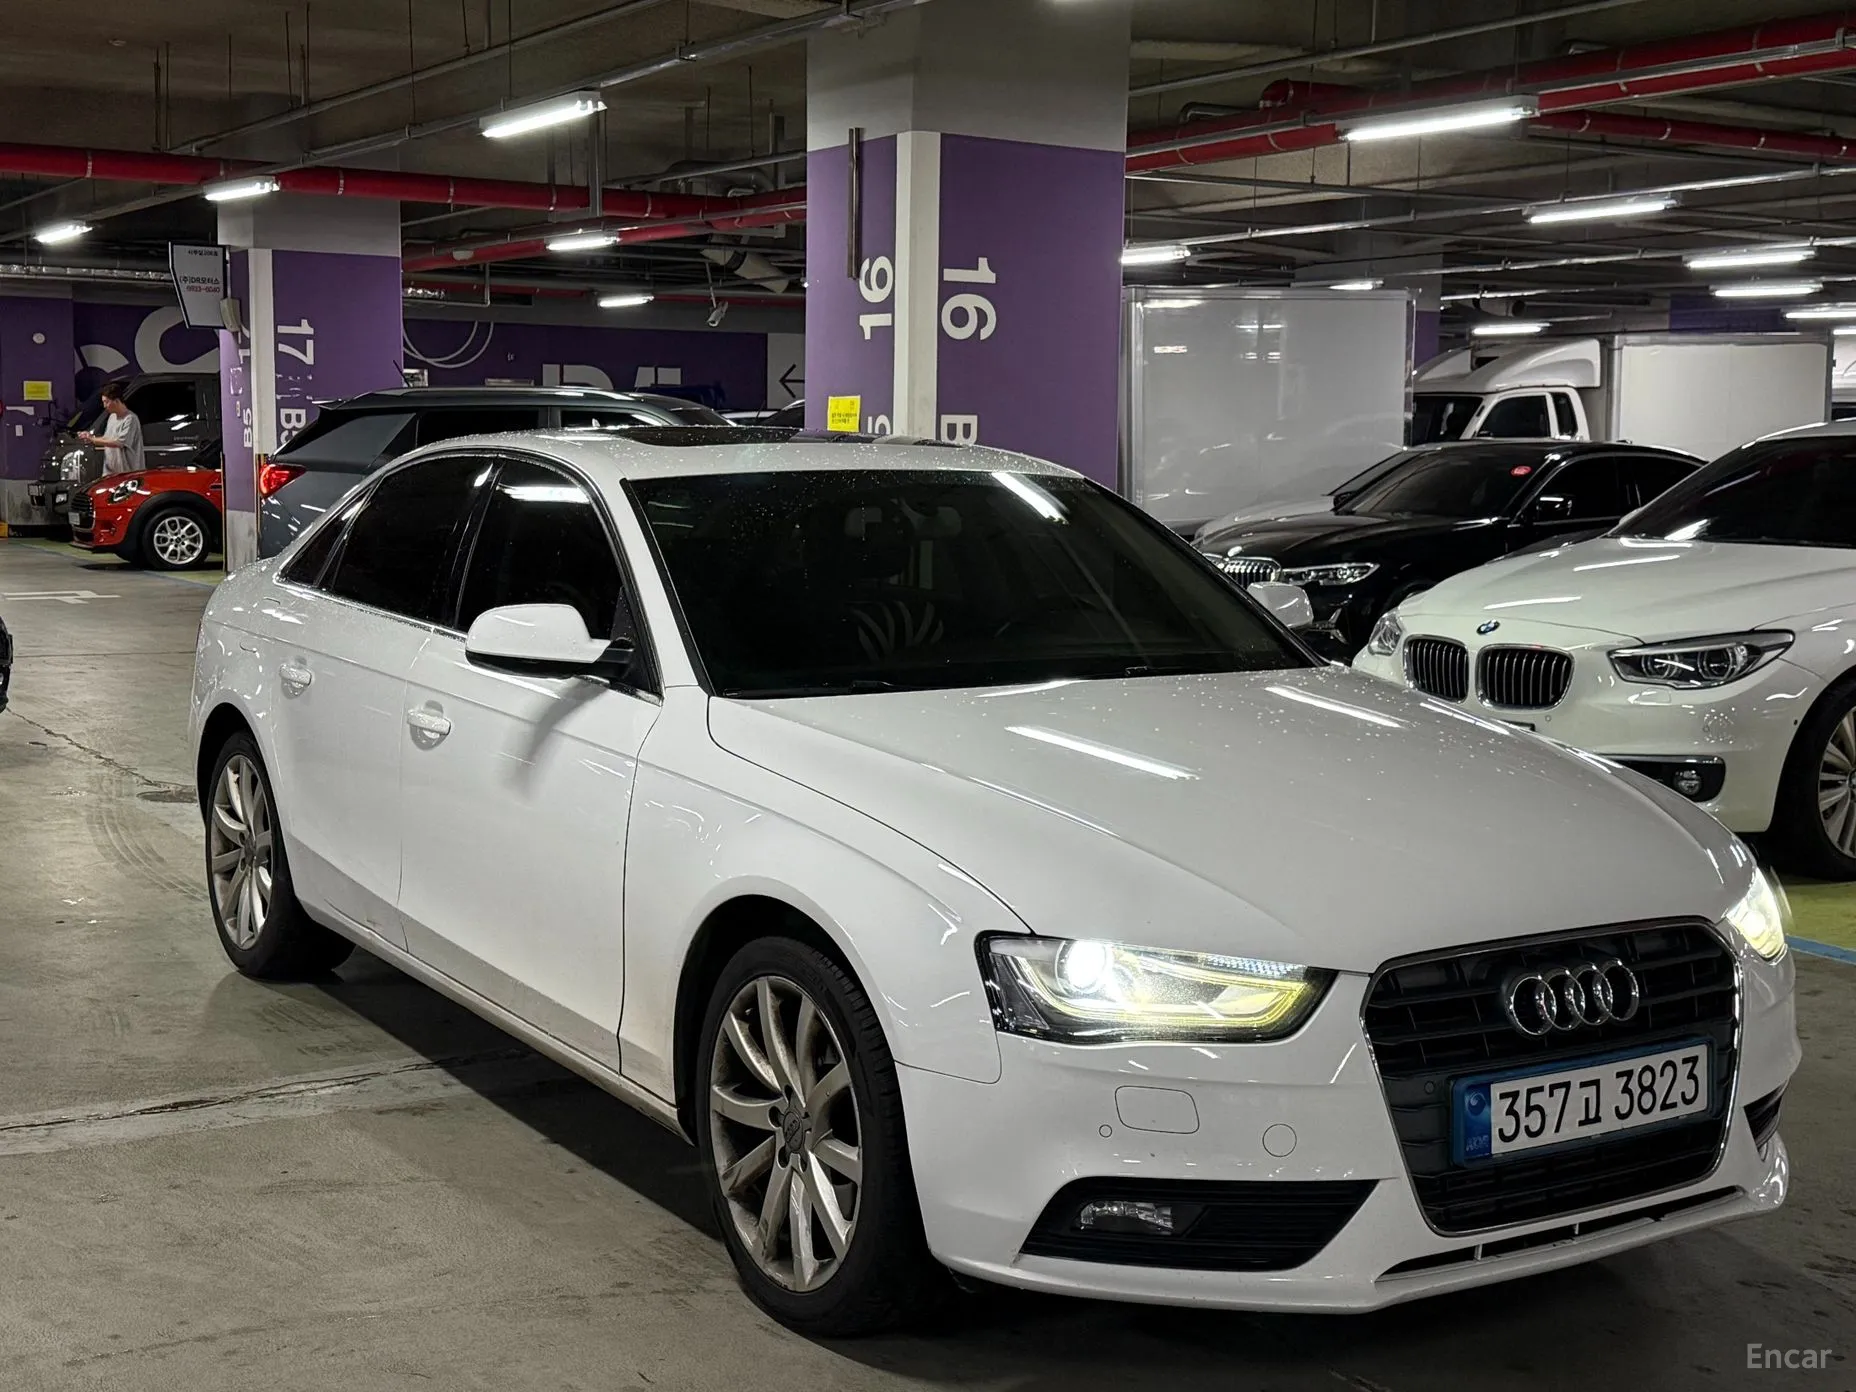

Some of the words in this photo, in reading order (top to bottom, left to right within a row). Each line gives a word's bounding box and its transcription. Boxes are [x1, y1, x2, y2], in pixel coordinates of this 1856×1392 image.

[941, 257, 997, 341] 16
[277, 319, 315, 365] 17
[1498, 1079, 1602, 1143] 357고
[1614, 1055, 1700, 1121] 3823
